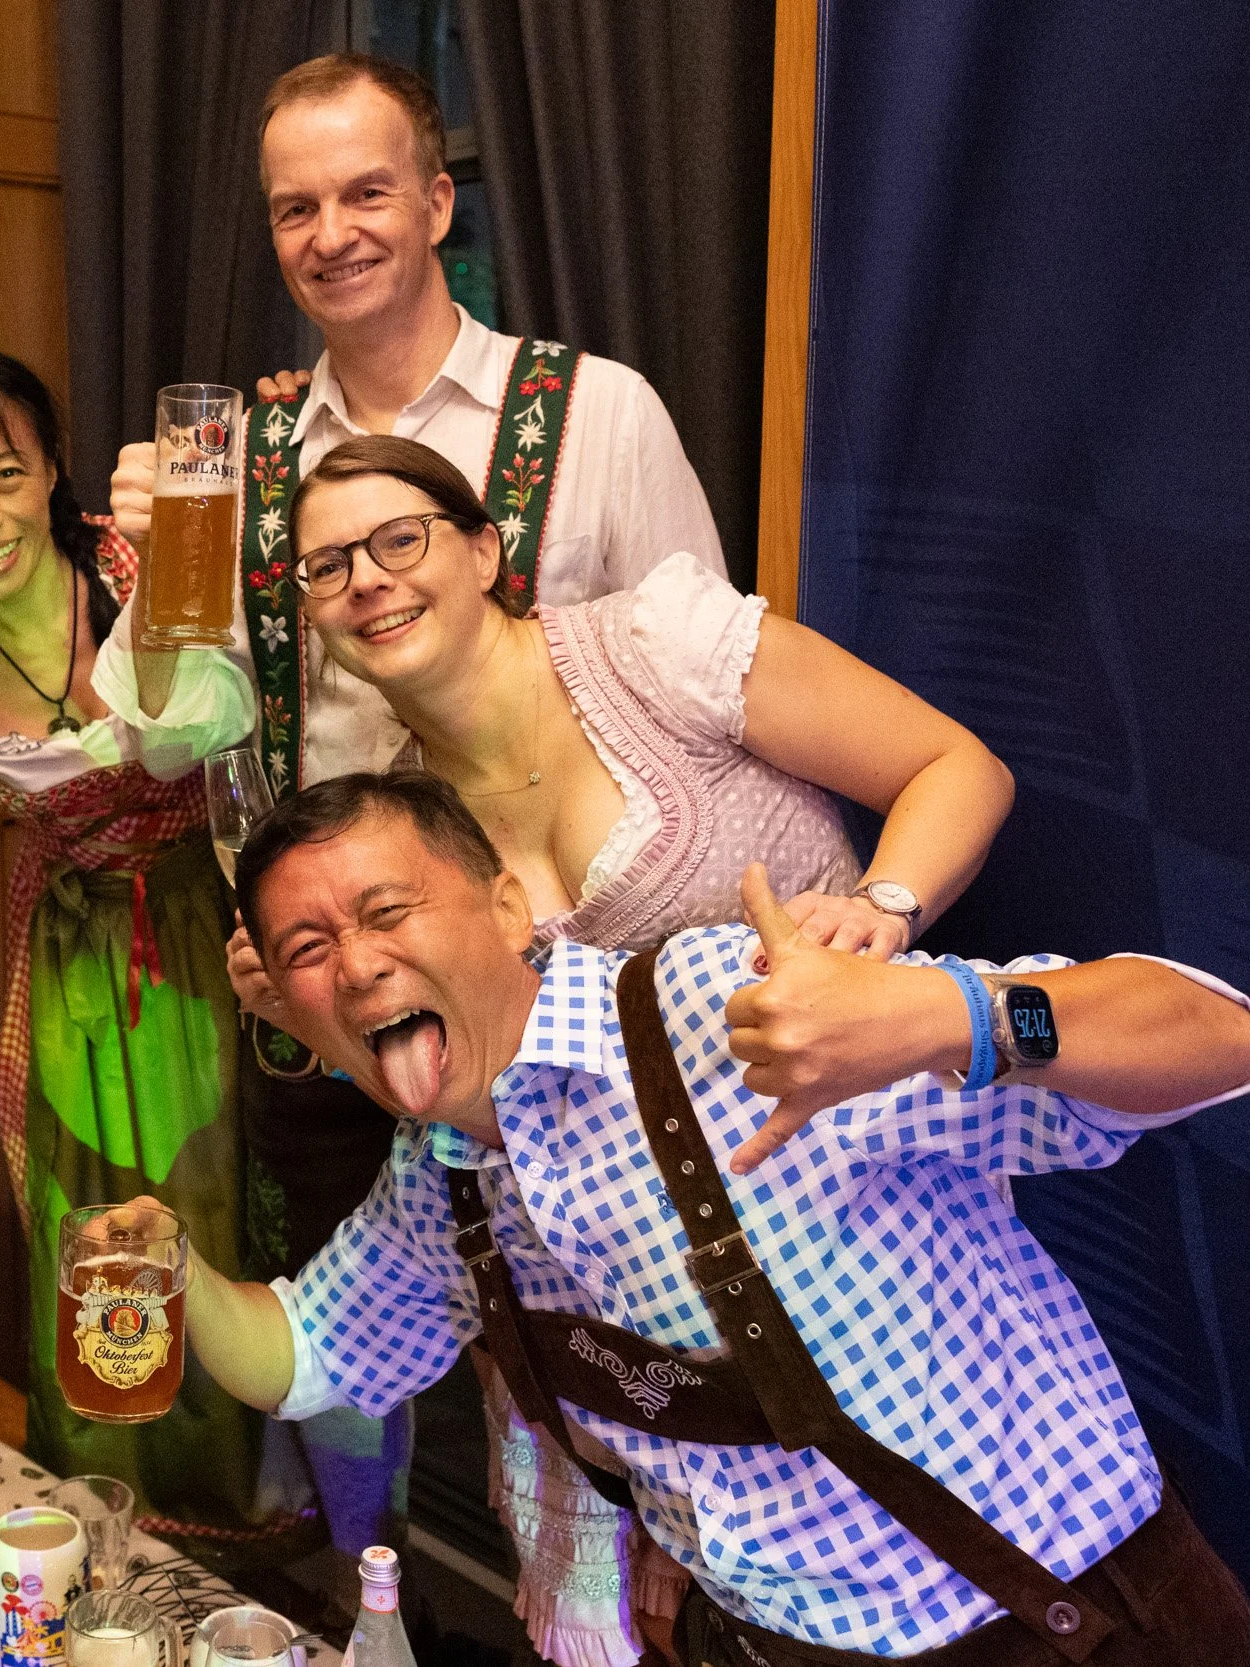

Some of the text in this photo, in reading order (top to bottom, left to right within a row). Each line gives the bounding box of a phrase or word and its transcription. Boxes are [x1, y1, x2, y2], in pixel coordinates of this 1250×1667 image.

[196, 416, 228, 432] PAULANER
[1014, 1009, 1050, 1038] 21:25
[104, 1299, 148, 1316] PAULANER
[94, 1345, 154, 1364] Oktoberfest
[110, 1361, 138, 1375] Bier
